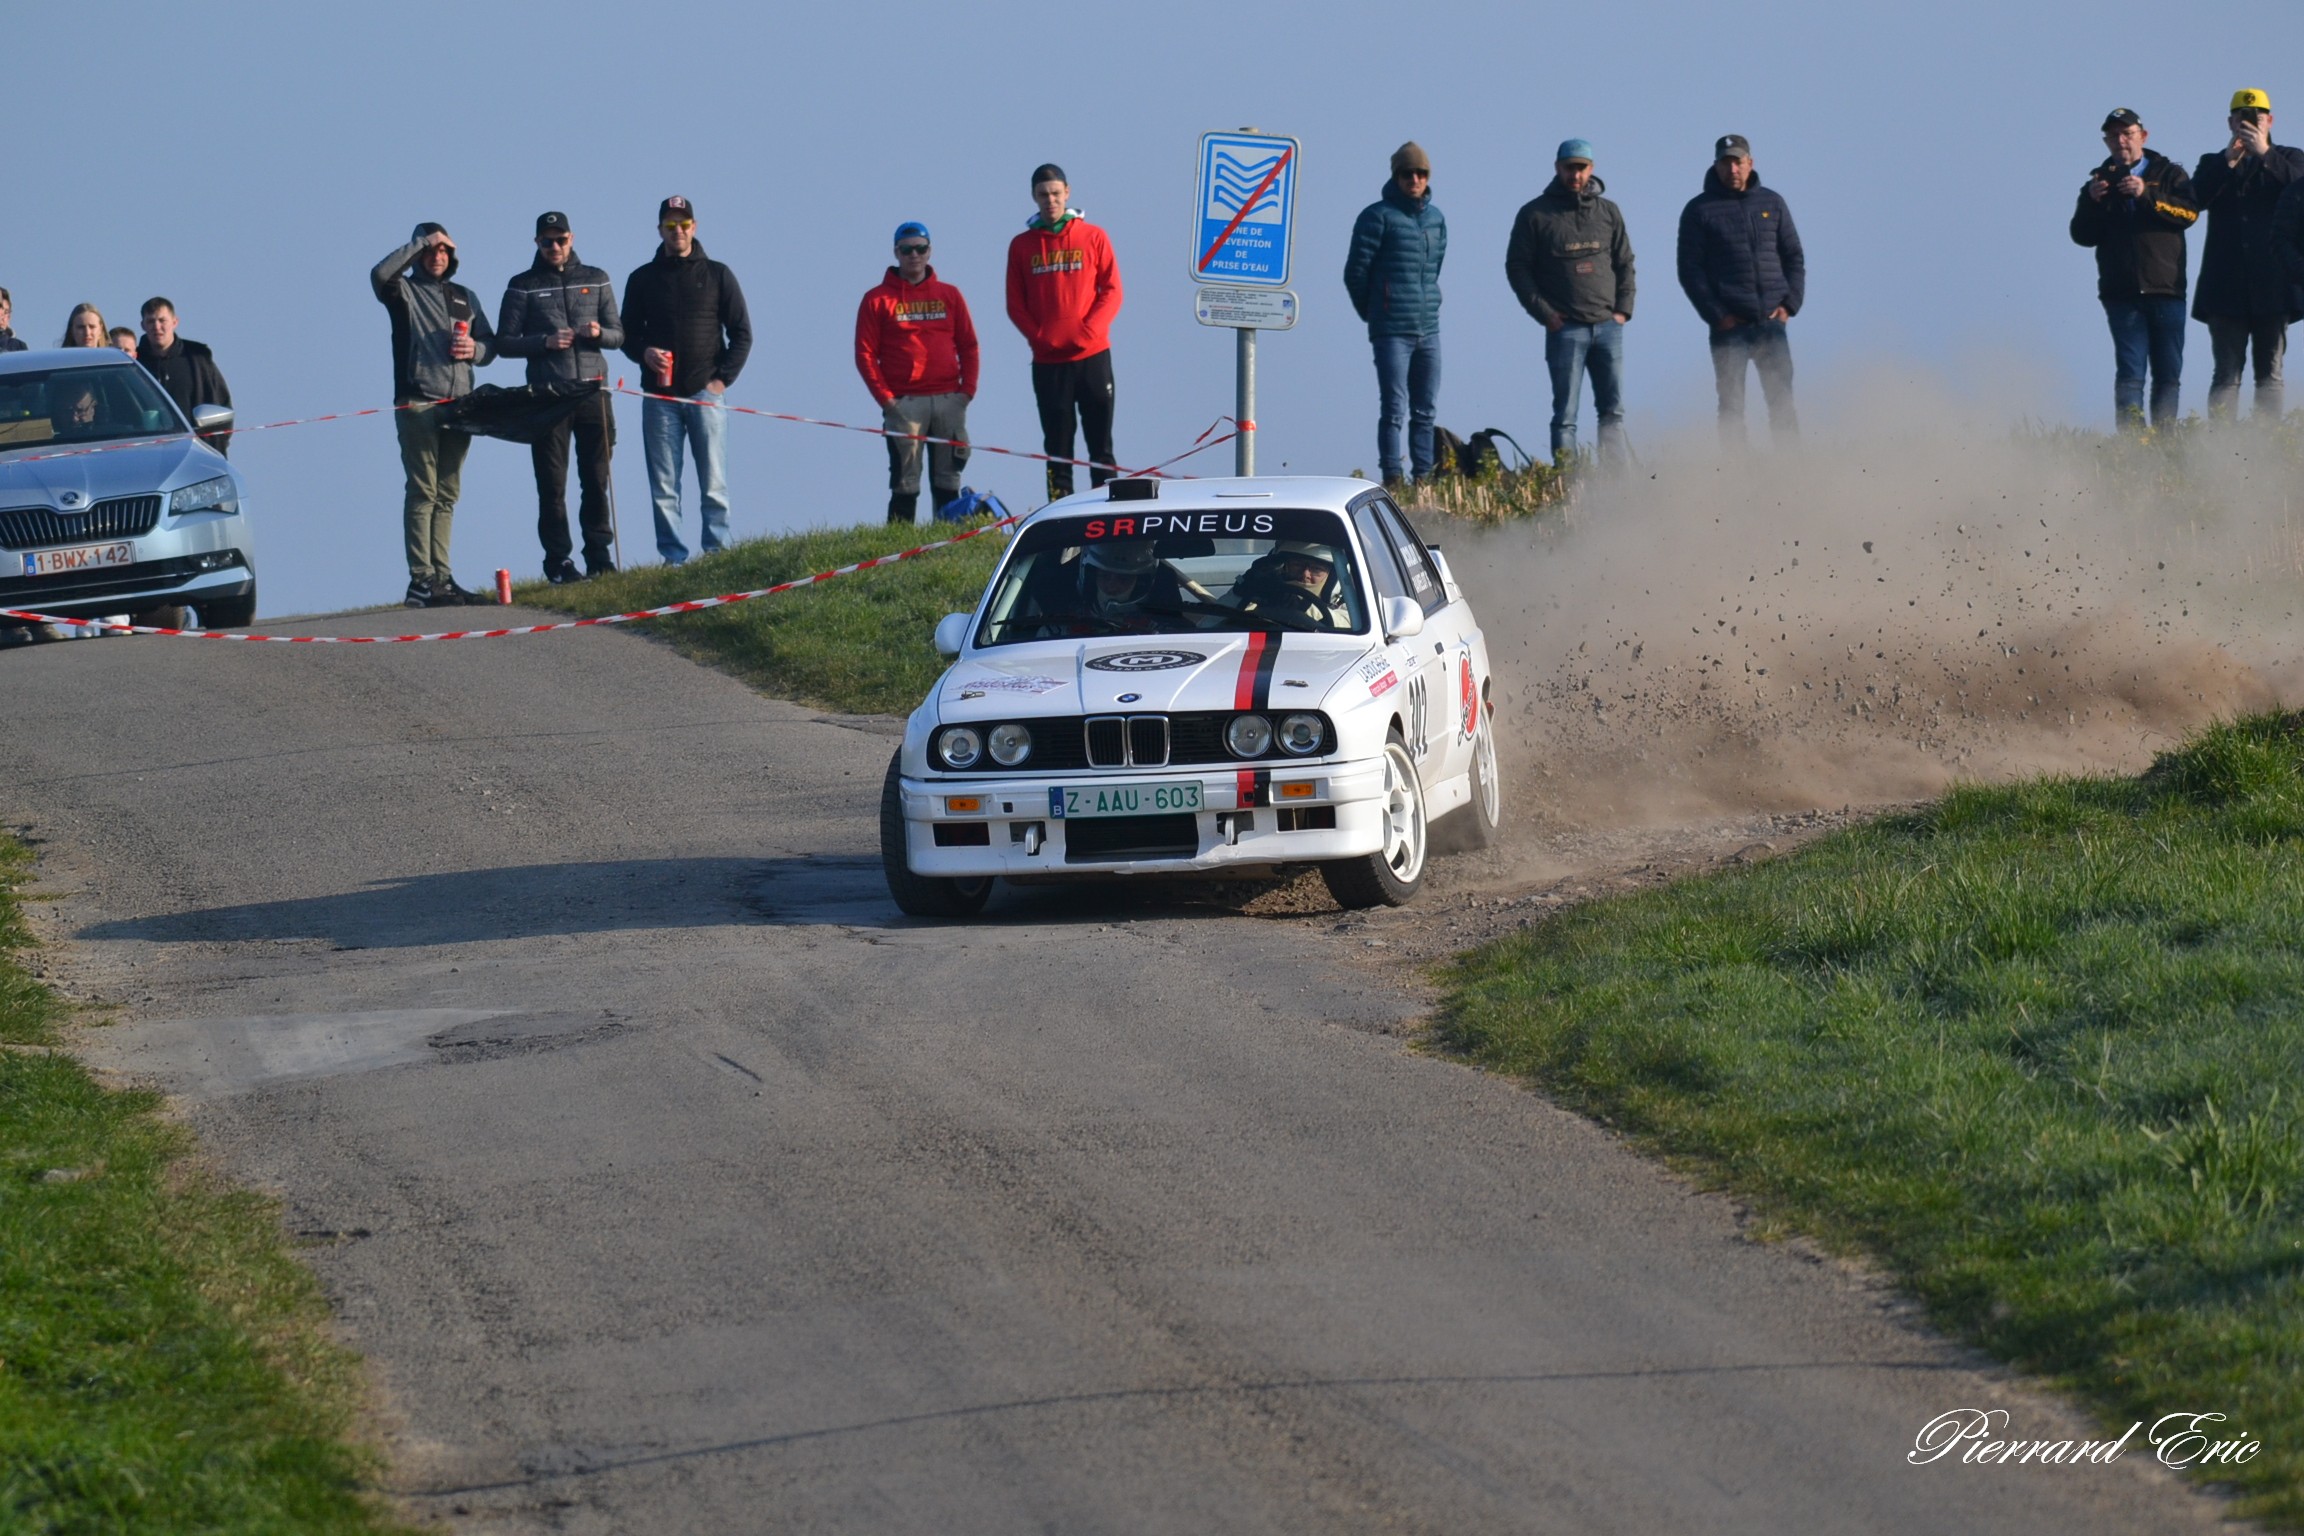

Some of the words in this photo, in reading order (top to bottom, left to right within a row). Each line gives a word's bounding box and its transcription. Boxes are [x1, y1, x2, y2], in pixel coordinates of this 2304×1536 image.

[1250, 227, 1263, 236] DE
[1235, 250, 1248, 259] DE
[1212, 260, 1240, 270] PRISE
[1242, 263, 1269, 272] D'EAU
[896, 301, 945, 314] OLIVIER
[1128, 656, 1164, 665] M
[1408, 673, 1429, 760] 302
[1053, 805, 1062, 815] B
[1066, 786, 1199, 813] Z-AAU-603
